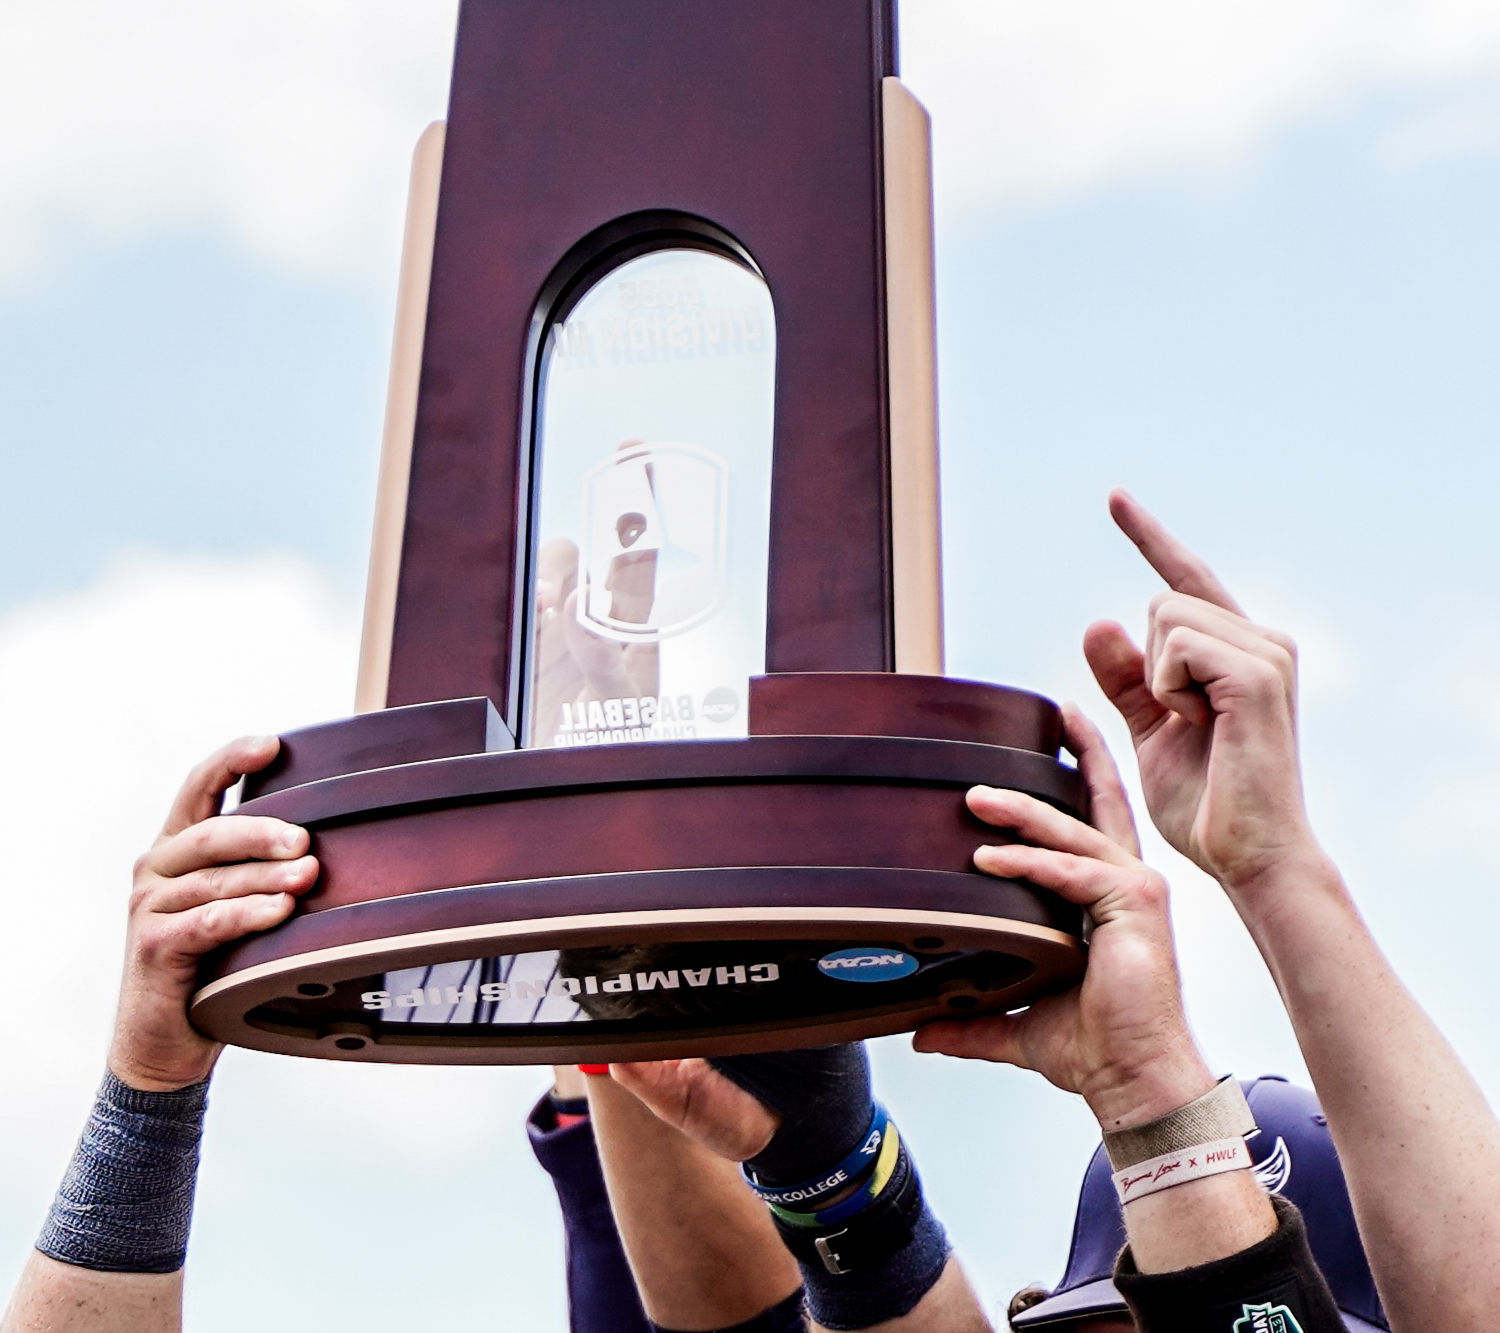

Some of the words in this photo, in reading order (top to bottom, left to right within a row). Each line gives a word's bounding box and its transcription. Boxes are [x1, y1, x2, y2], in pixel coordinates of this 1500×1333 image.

[360, 962, 780, 1011] CHAMPIONSHIPS
[1206, 1147, 1238, 1165] HWLF
[782, 1169, 849, 1202] COLLEGE
